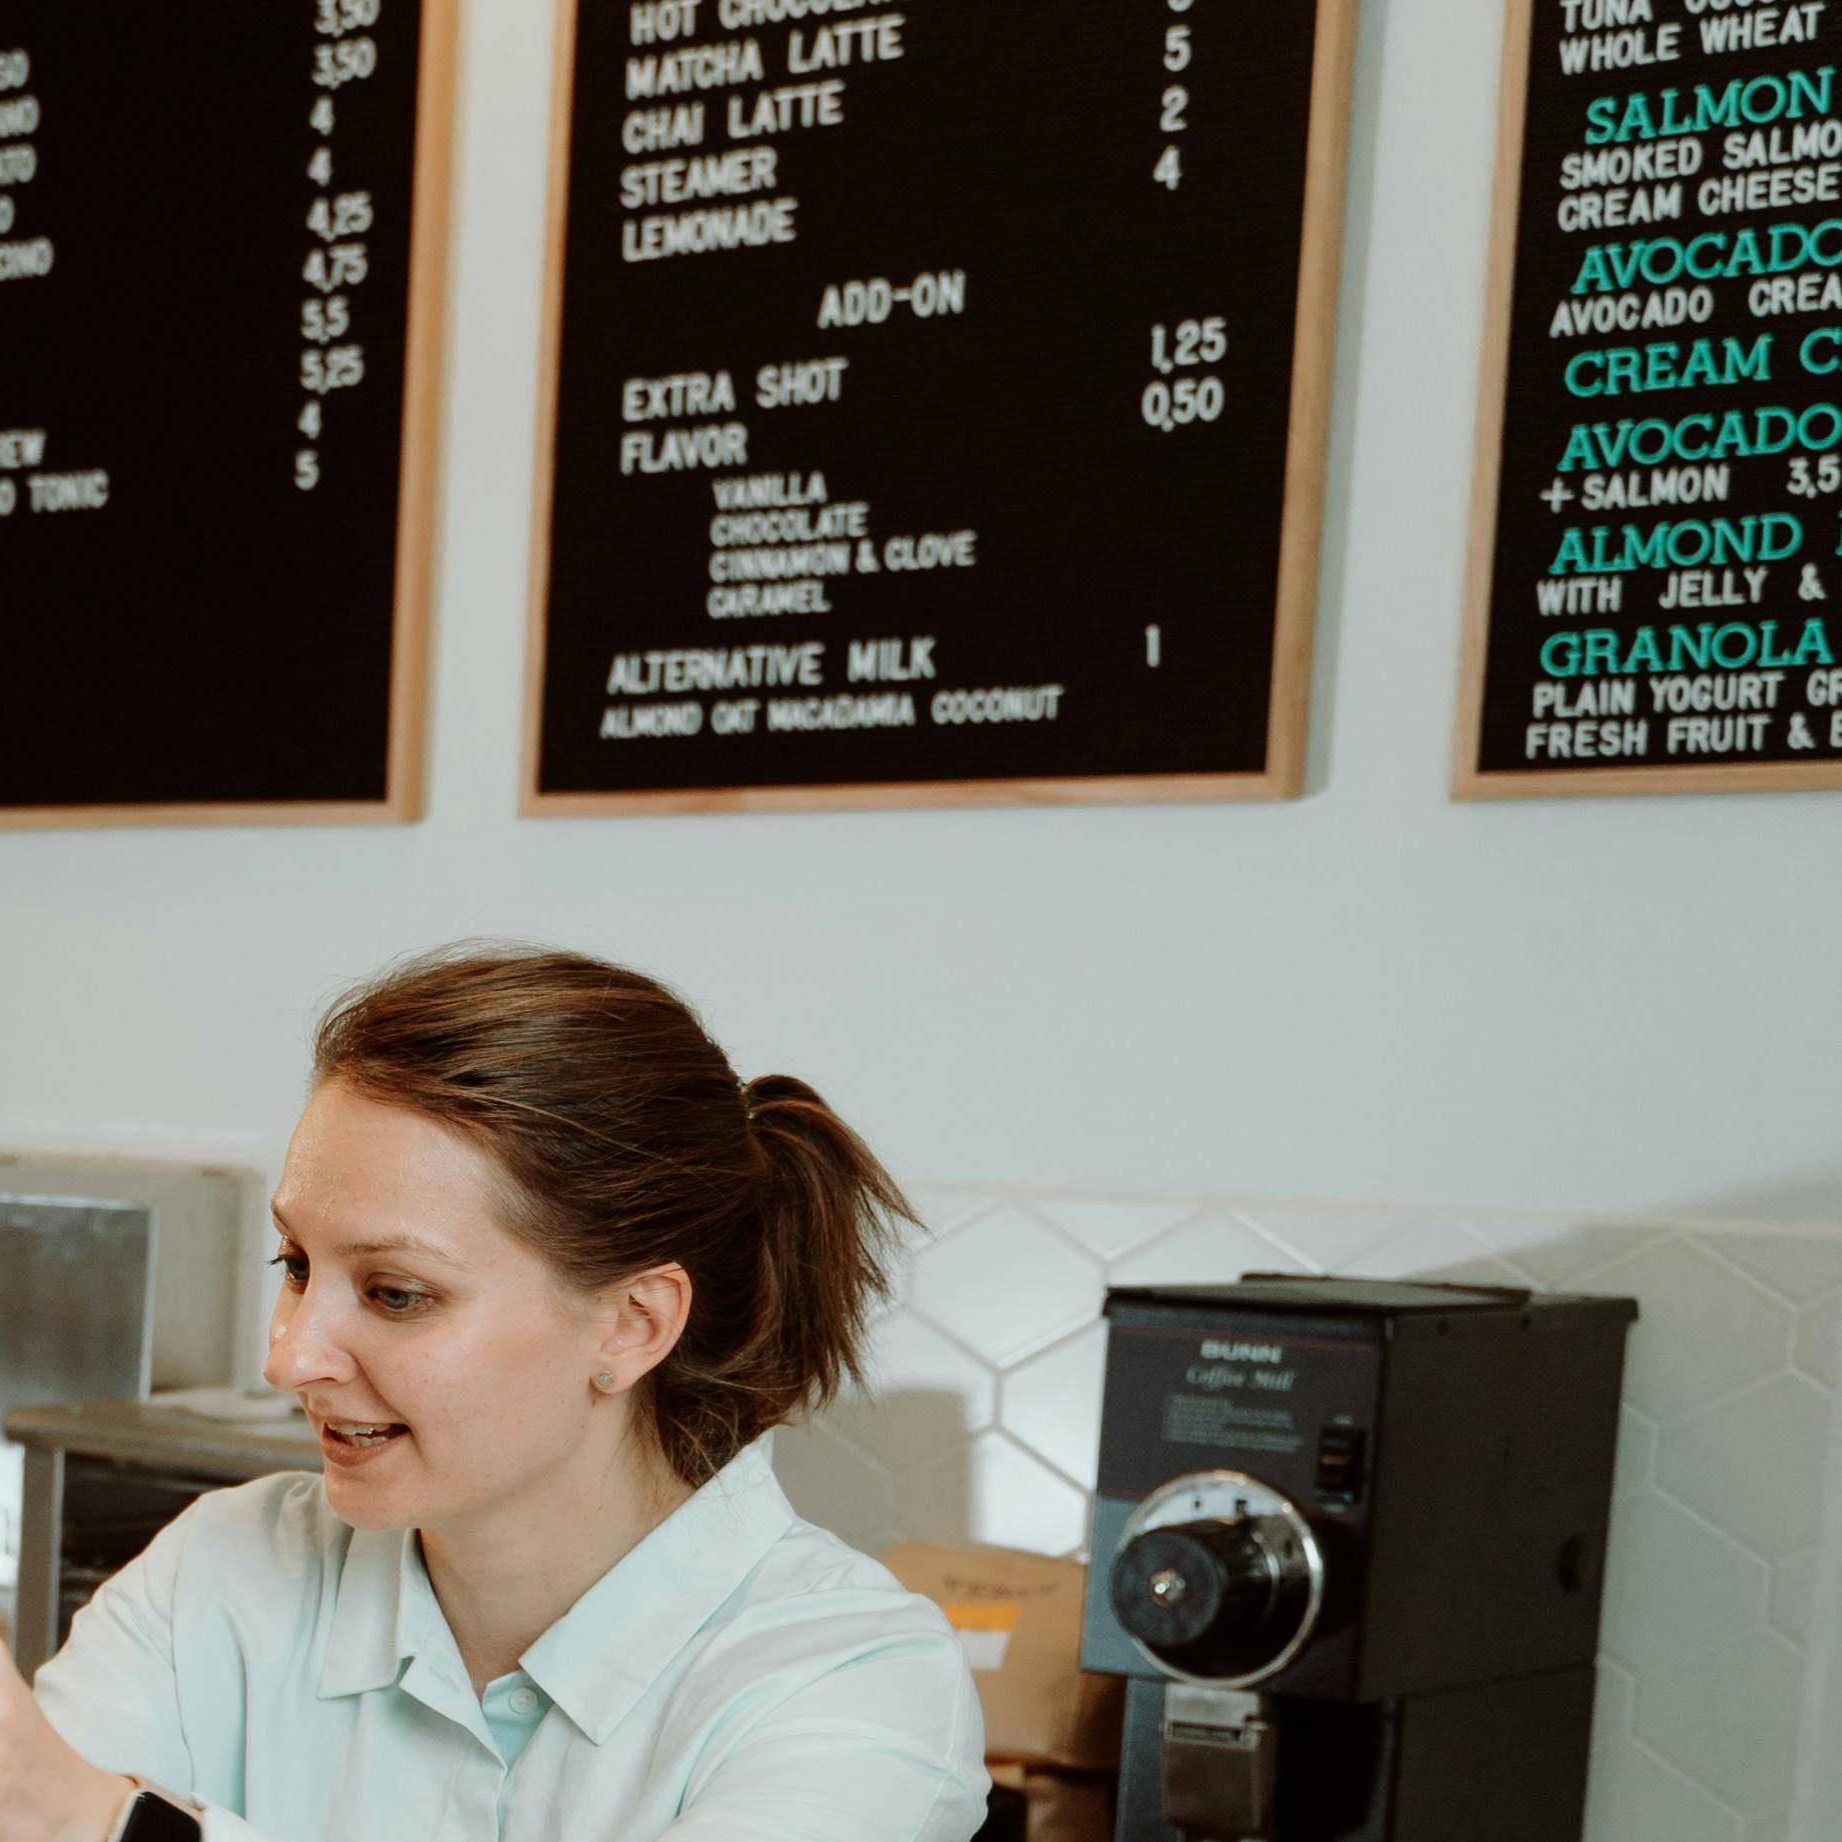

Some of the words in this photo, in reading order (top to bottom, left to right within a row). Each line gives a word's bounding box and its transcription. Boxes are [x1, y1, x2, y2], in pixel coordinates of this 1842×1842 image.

[630, 0, 702, 45] HOT
[1559, 0, 1653, 33] TUNA
[1559, 23, 1682, 75] WHOLE
[1699, 2, 1826, 54] WHEAT
[625, 39, 764, 100] MATCHA
[787, 13, 905, 74] LATTE
[310, 96, 334, 135] 4
[622, 102, 704, 154] CHAI
[727, 79, 845, 139] LATTE
[1163, 25, 1191, 71] 5
[1585, 65, 1835, 145] SALMON
[308, 147, 332, 186] 4
[620, 145, 777, 209] STEAMER
[1160, 86, 1188, 131] 2
[1559, 136, 1703, 190] SMOKED
[622, 197, 798, 262] LEMONADE
[1153, 146, 1181, 190] 4
[1557, 182, 1682, 232] CREAM
[1697, 162, 1842, 216] CHEESE
[1570, 218, 1842, 295] AVOCADO
[817, 272, 965, 329] ADD-ON
[1549, 285, 1714, 338] AVOCADO
[622, 372, 735, 422] EXTRA
[756, 358, 848, 409] SHOT
[1564, 334, 1773, 398] CREAM
[298, 401, 321, 438] 4
[1557, 402, 1842, 472] AVOCADO
[621, 423, 747, 474] FLAVOR
[27, 469, 108, 512] TONIC
[295, 450, 319, 490] 5
[713, 472, 827, 510] VANILLA
[1583, 463, 1730, 511] SALMON
[710, 502, 869, 547] CHOCOLATE
[1549, 512, 1803, 575] ALMOND
[709, 542, 850, 583] CINNAMON
[856, 538, 880, 573] &
[885, 530, 976, 571] CLOVE
[707, 580, 831, 619] CARAMEL
[1536, 574, 1622, 616] WITH
[1658, 566, 1768, 609] JELLY
[1798, 562, 1826, 601] &
[606, 641, 825, 694] ALTERNATIVE
[848, 636, 936, 682] MILK
[1145, 625, 1160, 667] 1
[1540, 617, 1834, 678] GRANOLA
[600, 702, 702, 738] ALMOND
[712, 699, 761, 734] OAT
[767, 692, 916, 731] MACADAMIA
[931, 684, 1064, 724] COCONUT
[1533, 678, 1636, 719] PLAIN
[1649, 671, 1785, 713] YOGURT
[1526, 718, 1648, 759] FRESH
[1667, 714, 1772, 754] FRUIT
[1787, 712, 1815, 750] &
